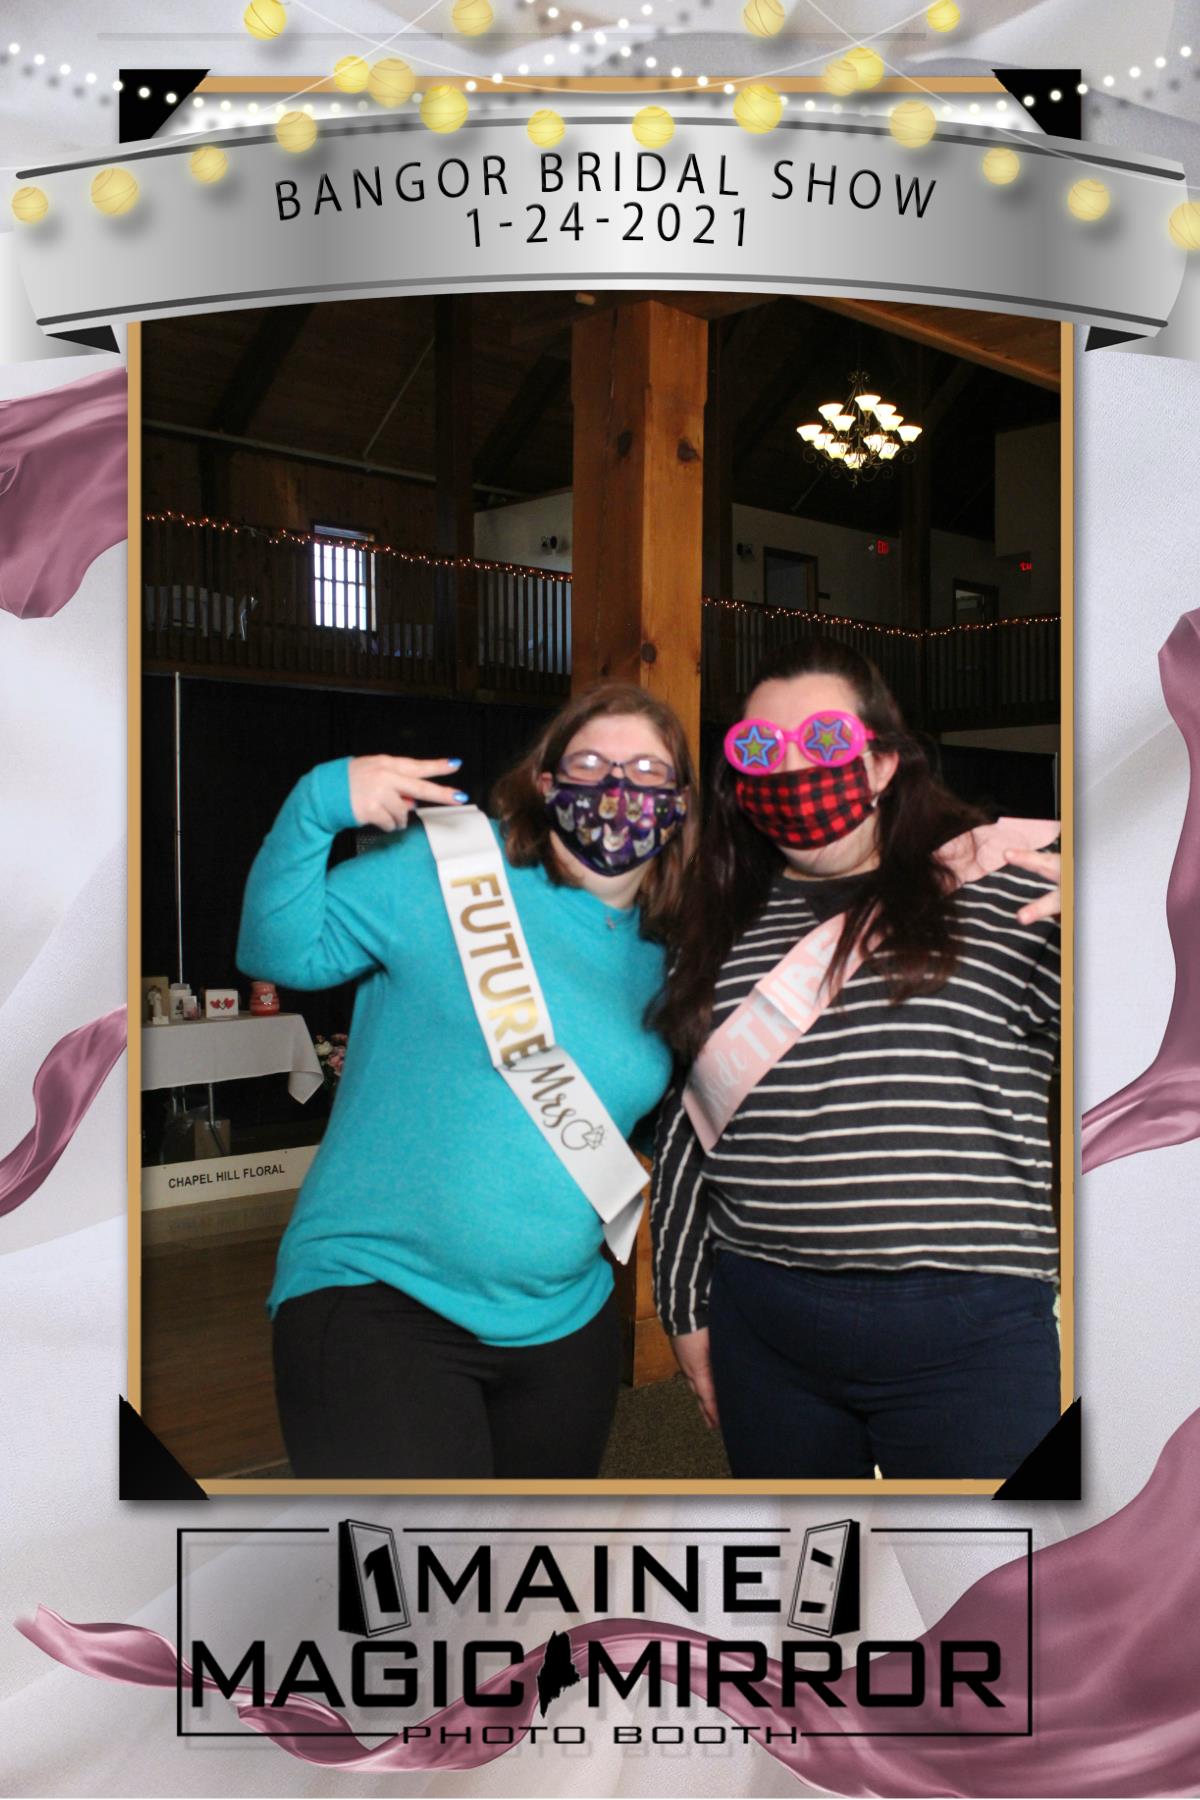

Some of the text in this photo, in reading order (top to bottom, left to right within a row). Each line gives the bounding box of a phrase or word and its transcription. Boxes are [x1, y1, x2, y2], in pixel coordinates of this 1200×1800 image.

[450, 872, 551, 1068] FUTURE
[508, 1063, 577, 1129] Mrs
[168, 1164, 285, 1189] CHAPEL HILL FLORAL
